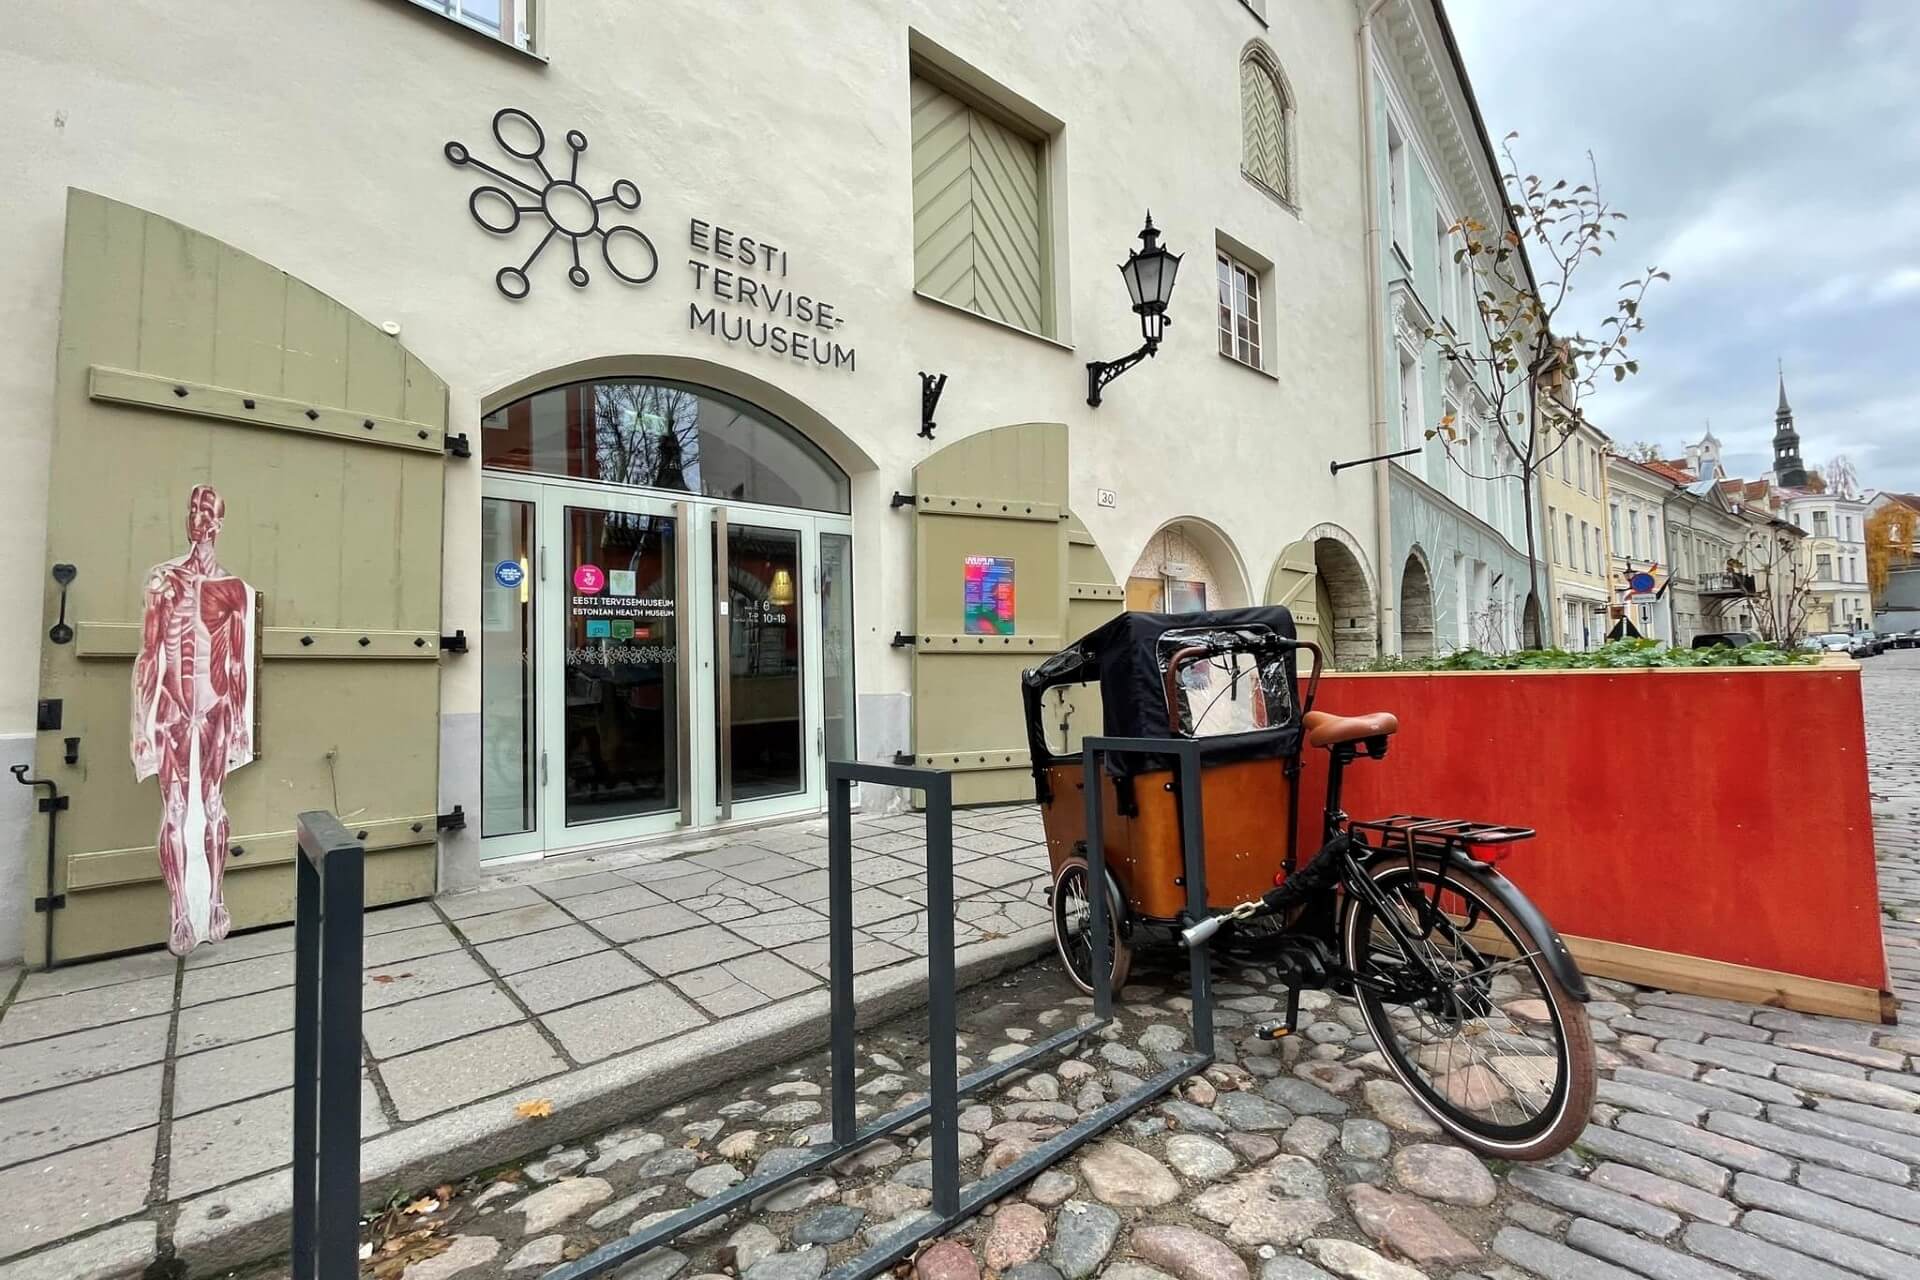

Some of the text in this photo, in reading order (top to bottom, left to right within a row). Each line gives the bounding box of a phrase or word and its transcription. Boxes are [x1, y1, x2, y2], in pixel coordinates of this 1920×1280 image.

[690, 217, 787, 277] EESTI
[688, 259, 844, 330] TERVISE-
[689, 302, 855, 372] MUUSEUM
[1102, 492, 1113, 505] 30
[572, 596, 674, 607] EESTI TERVISEMUUSEUM
[572, 608, 675, 617] ESTONIAN HEALTH MUSEUM
[763, 613, 786, 623] 10-18
